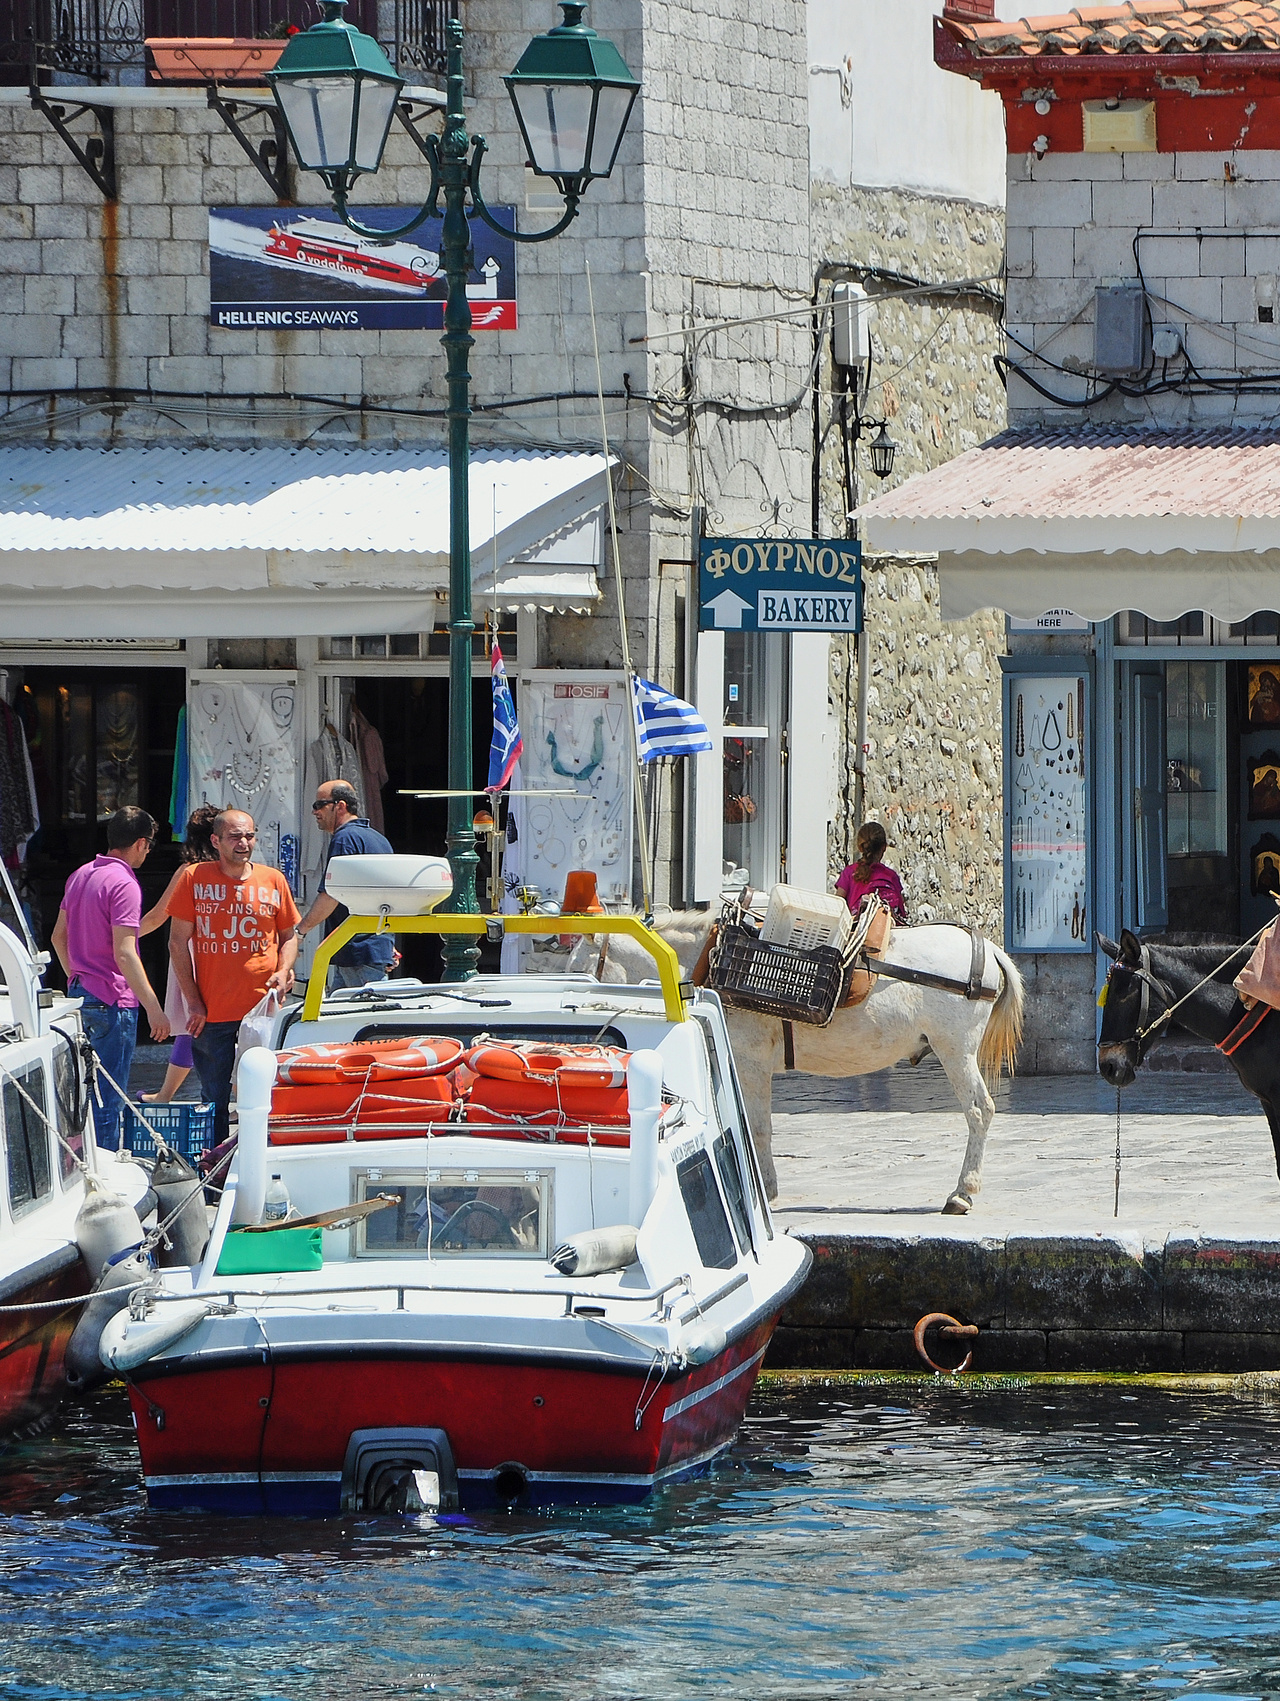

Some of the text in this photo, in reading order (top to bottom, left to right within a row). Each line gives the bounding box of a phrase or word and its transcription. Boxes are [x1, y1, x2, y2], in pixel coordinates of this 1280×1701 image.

[307, 256, 364, 275] vodafone
[218, 310, 359, 325] HELLENIC SEAWAYS
[705, 542, 857, 585] ΦΟΥΡΝΟΣ
[762, 596, 853, 623] BAKERY
[1037, 618, 1062, 627] HERE
[568, 685, 607, 698] IOSIF
